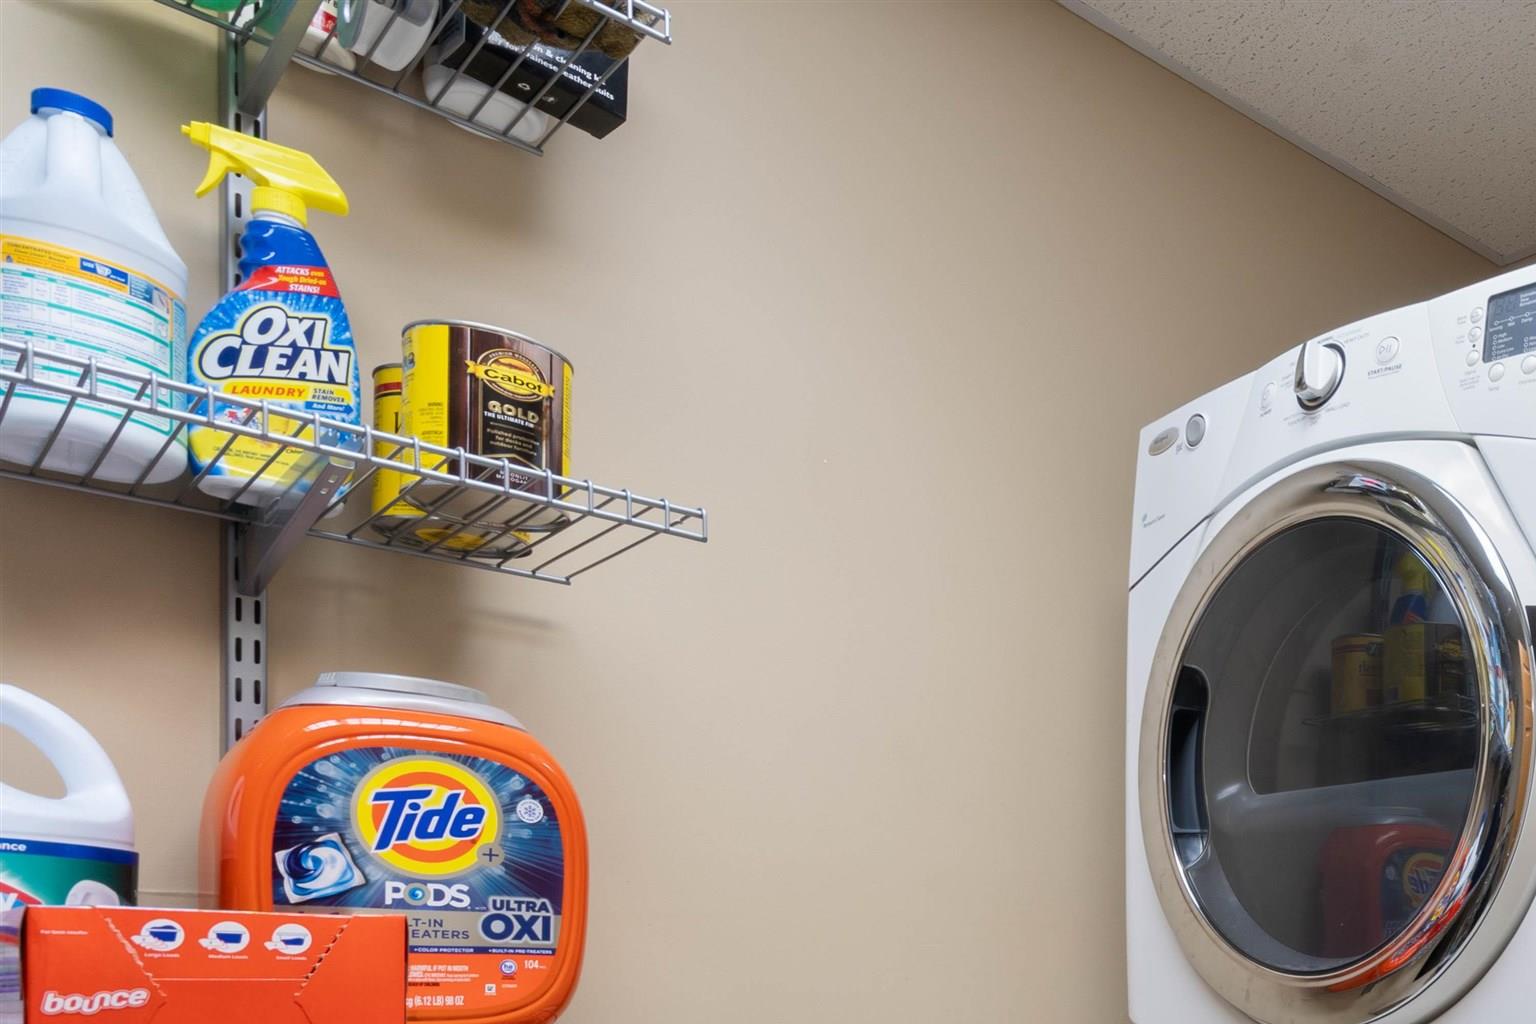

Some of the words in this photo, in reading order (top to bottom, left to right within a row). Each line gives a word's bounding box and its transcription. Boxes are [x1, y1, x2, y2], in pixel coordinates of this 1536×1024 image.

[555, 54, 593, 80] claning
[560, 68, 593, 90] eather
[275, 266, 310, 277] ATTACKS
[288, 284, 321, 294] STAINS!
[241, 306, 327, 349] OXI
[199, 334, 352, 386] CLEAN
[484, 368, 543, 394] Cabot
[231, 386, 306, 398] LAUNDRY
[311, 394, 346, 404] REMOVER
[313, 388, 335, 396] STAIN
[484, 411, 496, 419] THE
[496, 413, 525, 426] ULTIMATE
[487, 400, 540, 424] GOLD
[370, 788, 487, 852] Tide
[0, 841, 27, 851] nce
[492, 899, 550, 913] ULTRA
[409, 917, 444, 928] T-IN
[481, 913, 551, 942] OXI
[411, 929, 470, 940] EATERS
[524, 959, 539, 970] 104
[41, 988, 149, 1014] bounce
[455, 996, 465, 1006] OZ
